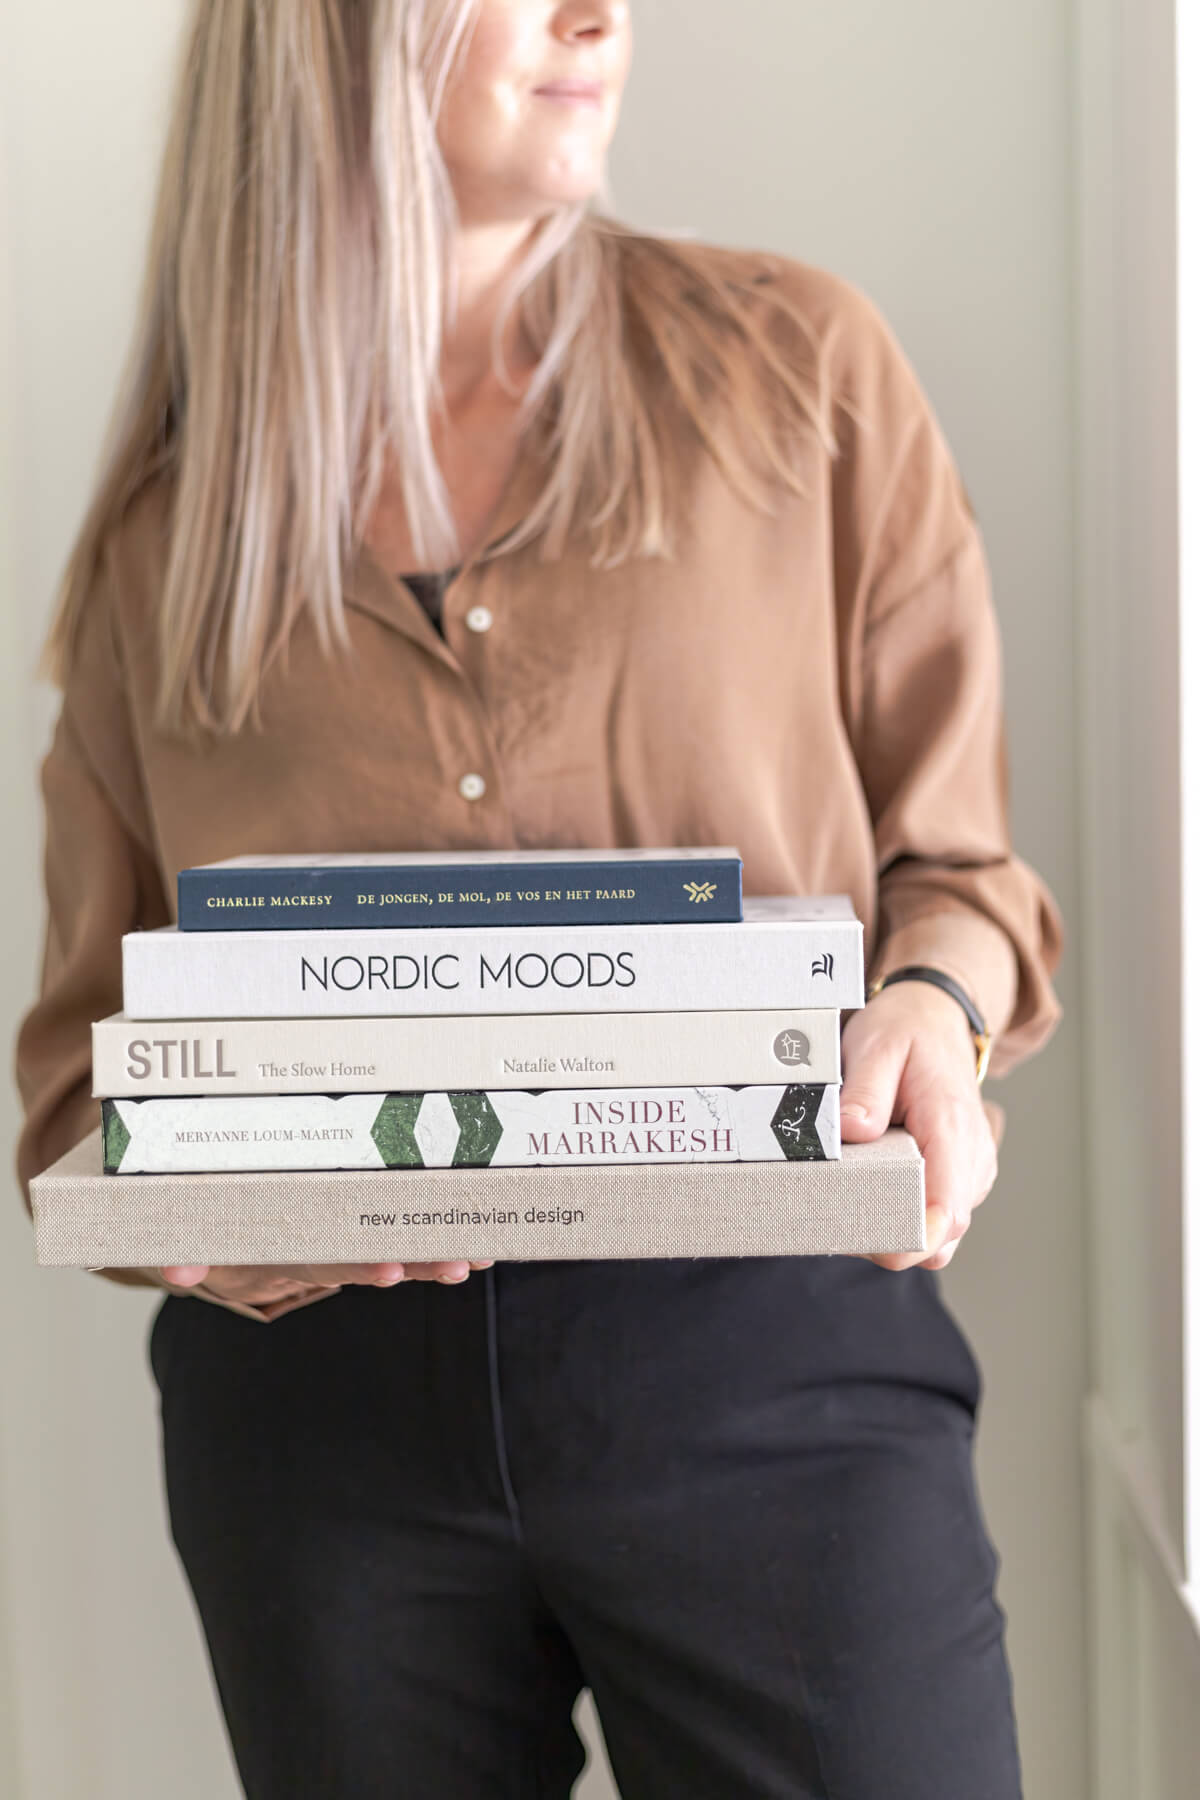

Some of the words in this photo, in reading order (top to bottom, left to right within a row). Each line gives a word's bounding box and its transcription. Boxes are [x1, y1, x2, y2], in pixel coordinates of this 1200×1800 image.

[206, 896, 265, 907] CHARLIE
[270, 895, 333, 906] MACKESY
[357, 894, 376, 904] DE
[379, 893, 434, 905] JONGEN,
[438, 893, 455, 903] DE
[459, 892, 492, 904] MOL,
[495, 891, 512, 901] DE
[516, 890, 541, 901] VOS
[545, 890, 562, 900] EN
[566, 890, 592, 899] HET
[595, 889, 637, 899] PAARD
[301, 954, 460, 990] NORDIC
[479, 952, 636, 988] MOODS
[127, 1039, 237, 1079] STILL
[502, 1058, 557, 1073] Natalie
[559, 1057, 616, 1072] Walton
[257, 1063, 288, 1077] The
[290, 1062, 327, 1077] Slow
[330, 1062, 376, 1076] Home
[572, 1099, 686, 1125] INSIDE
[175, 1130, 250, 1143] MERYANNE
[253, 1128, 354, 1142] LOUM-MARTIN
[527, 1128, 734, 1155] MARRAKESH
[359, 1212, 396, 1226] new
[402, 1207, 518, 1225] scandinavian
[524, 1206, 585, 1225] design
